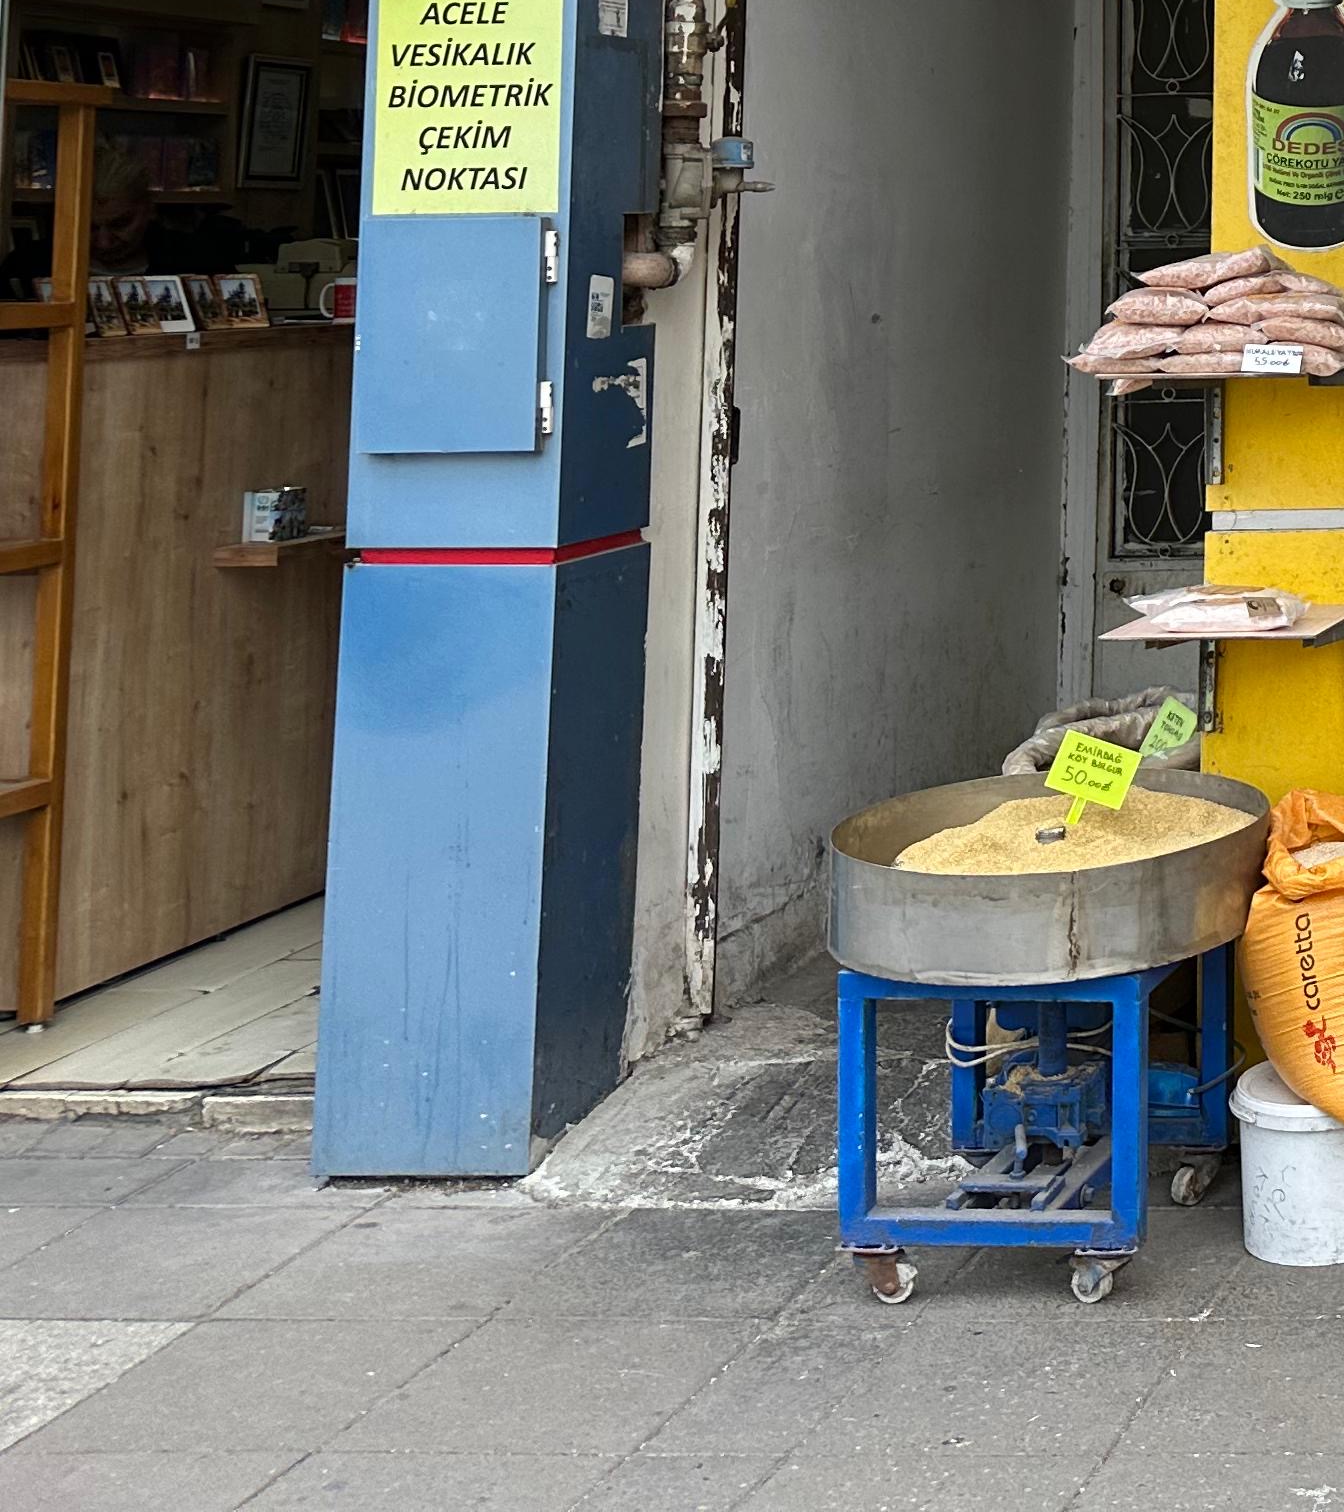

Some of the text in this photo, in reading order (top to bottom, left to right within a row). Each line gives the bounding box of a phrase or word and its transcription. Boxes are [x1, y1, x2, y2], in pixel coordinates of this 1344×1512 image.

[420, 1, 509, 25] ACELE
[391, 37, 536, 67] VESİKALIK
[388, 78, 553, 108] BİOMETRİK
[418, 120, 511, 155] ÇEKİM
[401, 167, 527, 191] NOKTASI
[1294, 912, 1321, 1011] caretta
